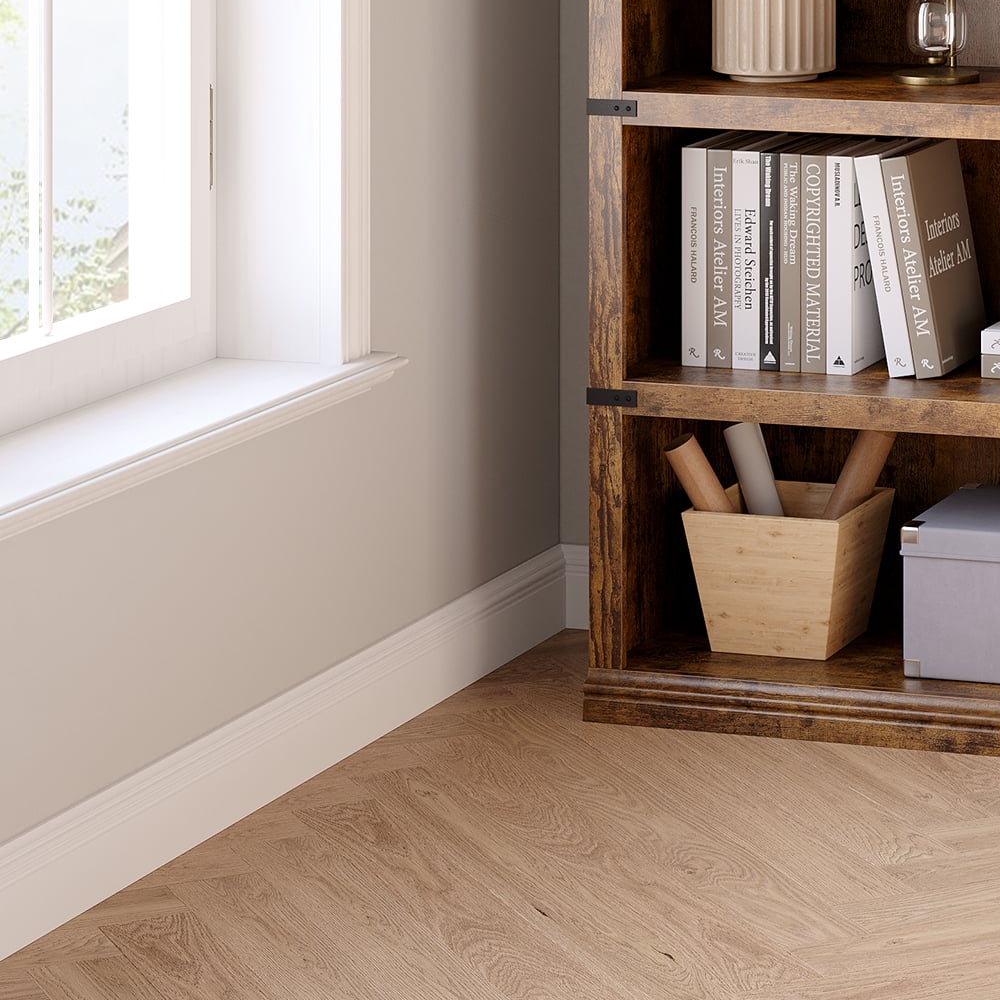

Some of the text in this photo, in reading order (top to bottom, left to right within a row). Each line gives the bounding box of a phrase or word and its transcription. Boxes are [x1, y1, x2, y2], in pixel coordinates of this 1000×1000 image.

[788, 186, 798, 226] Waking
[925, 212, 960, 241] Interiors
[713, 167, 728, 327] Interiors Atelier AM
[734, 235, 741, 244] IN
[744, 209, 756, 310] Edward Steichen
[790, 230, 798, 264] Dream
[806, 164, 820, 363] COPYRIGHTED MATERIAL
[873, 216, 891, 292] FRANCOIS HALARD
[891, 174, 930, 336] Interiors Atelier AM
[929, 238, 972, 278] Atelier AM
